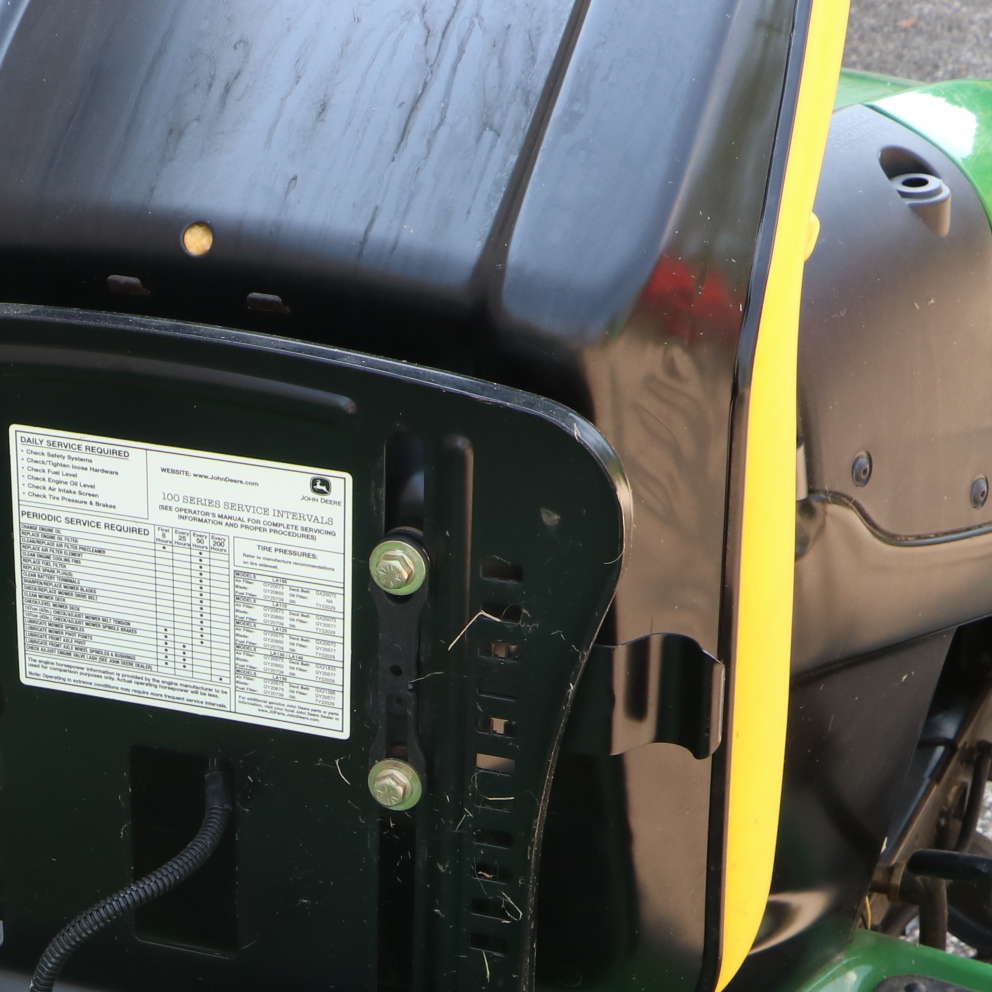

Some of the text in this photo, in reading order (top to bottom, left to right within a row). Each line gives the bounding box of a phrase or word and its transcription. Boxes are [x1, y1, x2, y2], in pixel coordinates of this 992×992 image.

[20, 435, 129, 458] DAILY SERVICE REQUIRED
[26, 448, 92, 464] Check Safety Systems
[26, 457, 70, 469] Check/Tighten
[89, 466, 118, 475] Hardware
[26, 465, 45, 473] Check
[27, 474, 45, 482] Check
[47, 477, 68, 486] Engine
[160, 467, 258, 486] WEBSITE: www.JohnDeere.com
[27, 482, 46, 490] Check
[58, 487, 76, 495] Intake
[78, 490, 99, 498] Screen
[61, 496, 87, 505] Pressure
[95, 501, 116, 509] Brakes
[300, 494, 341, 506] JOHN DEERE
[161, 492, 333, 526] 100 SERIES SERVICE INTERVALS
[20, 509, 149, 536] PERIODIC SERVICE REQUIRED
[158, 503, 336, 537] (SEE OPERATOR'S MANUAL FOR COMPLETE SERVICING
[177, 514, 316, 541] INFORMATION AND PROPER PROCEDURES)
[174, 529, 190, 537] Every
[192, 532, 207, 540] Every
[211, 535, 226, 543] Every
[191, 542, 208, 550] Hours
[210, 545, 227, 553] Hours
[256, 544, 318, 559] TIRE PRESSURES:
